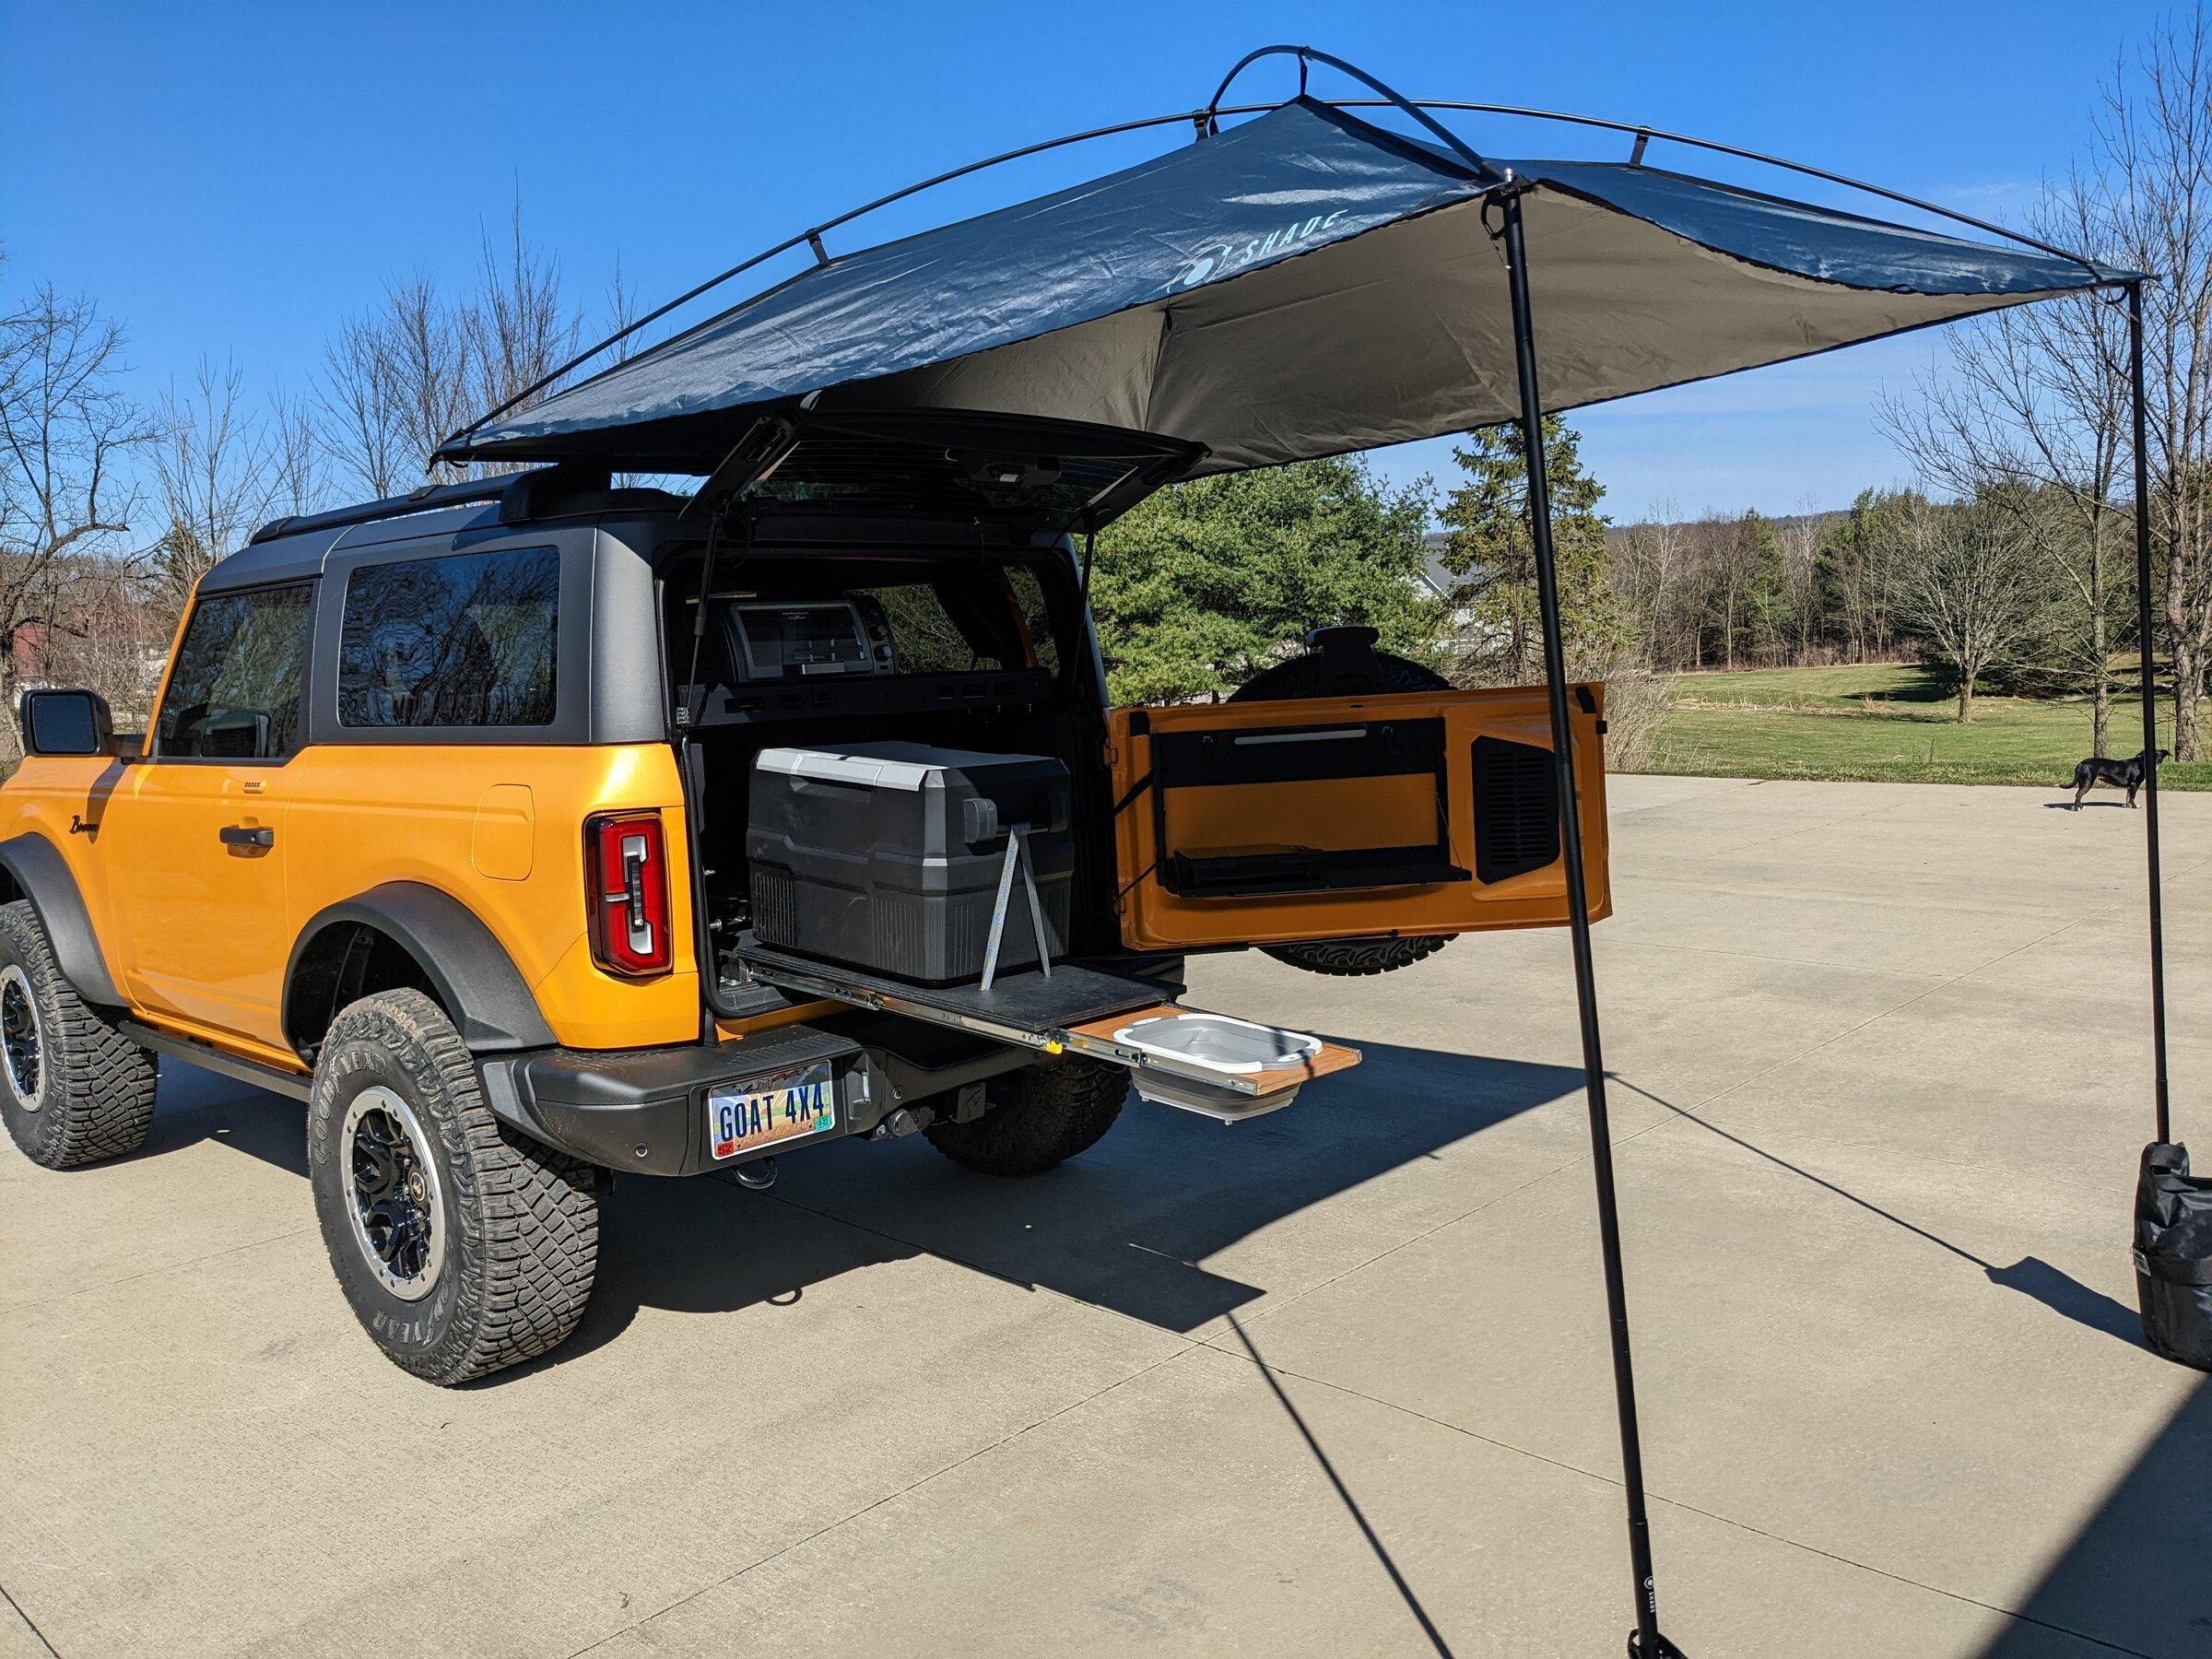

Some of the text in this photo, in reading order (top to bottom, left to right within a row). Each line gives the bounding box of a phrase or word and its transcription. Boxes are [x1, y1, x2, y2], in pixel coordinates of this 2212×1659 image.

[1239, 208, 1348, 265] SHADE
[720, 1083, 824, 1142] GOAT 4X4
[718, 1146, 732, 1156] 52
